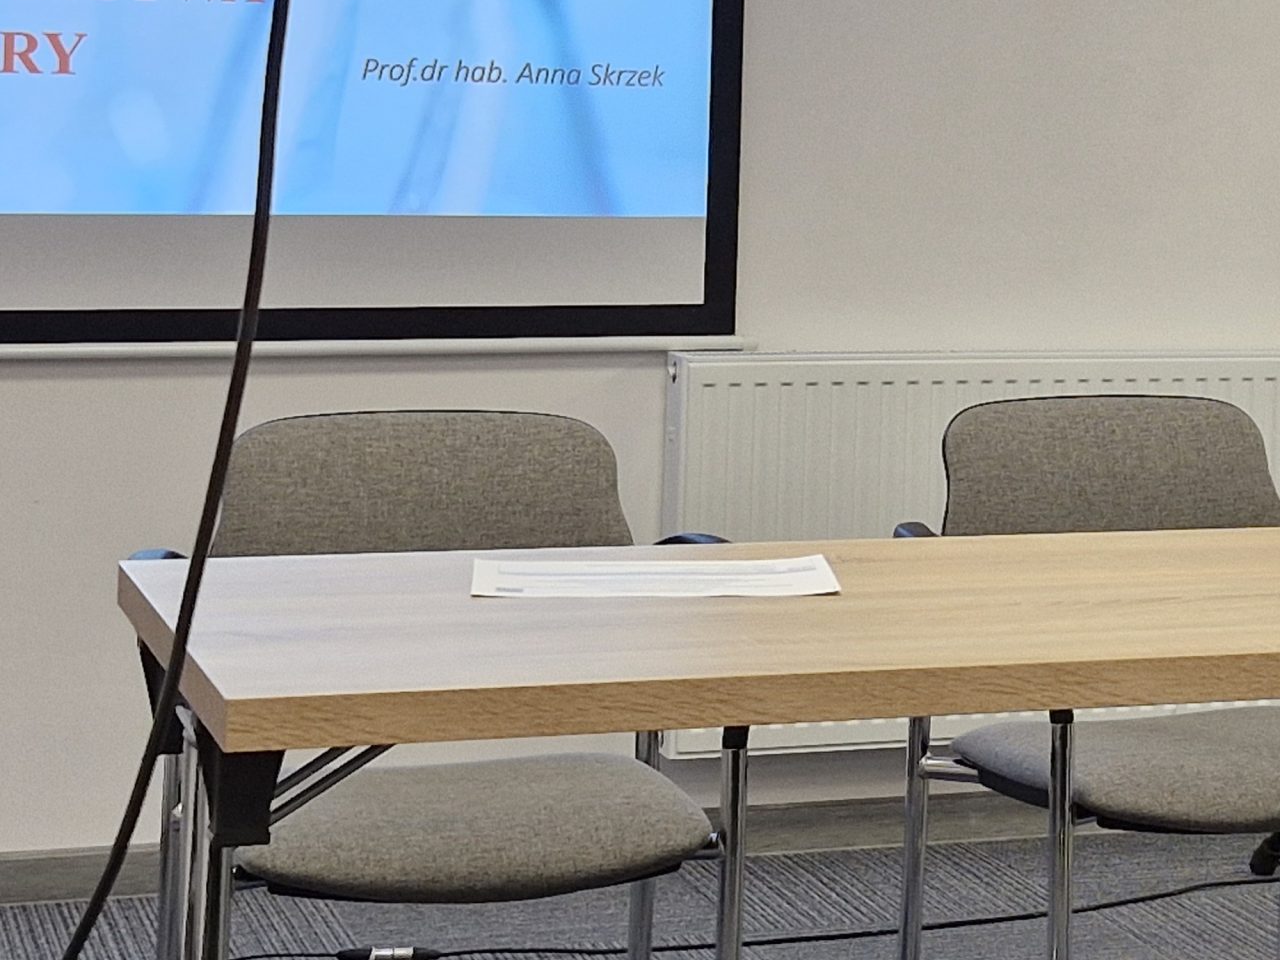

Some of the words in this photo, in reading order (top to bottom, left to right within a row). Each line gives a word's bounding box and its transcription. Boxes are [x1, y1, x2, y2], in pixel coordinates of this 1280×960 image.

[454, 60, 508, 84] hab.
[515, 62, 581, 86] Anna
[588, 63, 666, 87] Skrzek
